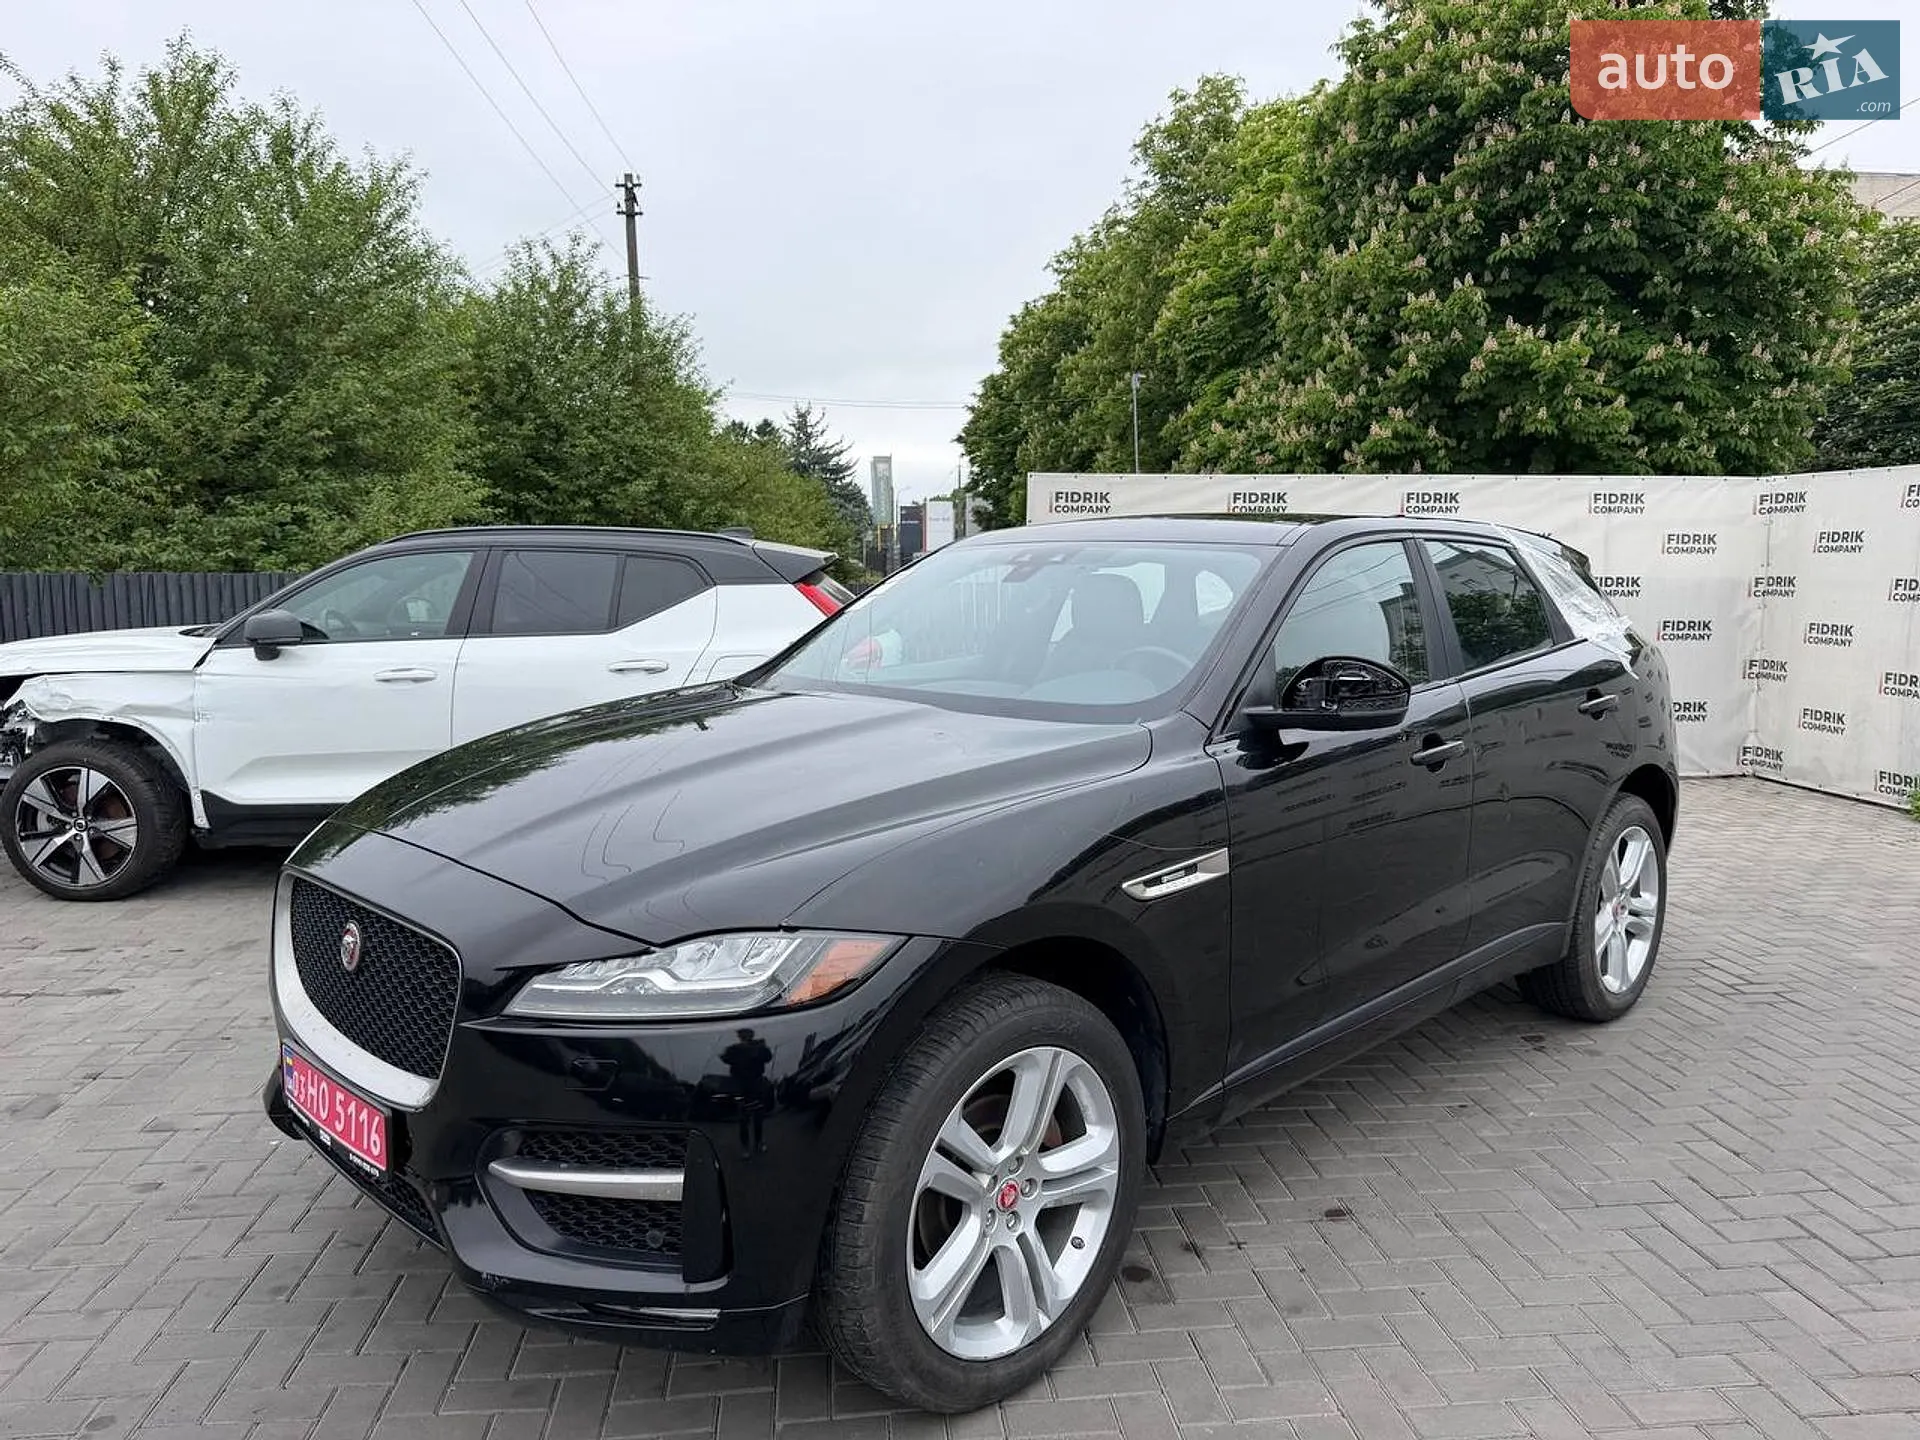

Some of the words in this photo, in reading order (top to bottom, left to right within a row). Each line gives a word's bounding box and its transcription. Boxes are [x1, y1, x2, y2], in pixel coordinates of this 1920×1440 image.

[1054, 491, 1111, 503] FIDRIK
[1232, 492, 1288, 504] FIDRIK
[1405, 492, 1460, 504] FIDRIK
[1593, 493, 1645, 504] FIDRIK
[1759, 491, 1808, 505] FIDRIK
[1054, 505, 1111, 513] COMPANY
[1405, 505, 1460, 513] COMPANY
[1593, 505, 1645, 514] COMPANY
[1666, 533, 1717, 545] FIDRIK
[1817, 530, 1865, 544] FIDRIK
[1665, 546, 1717, 555] COMPANY
[1817, 543, 1864, 553] COMPANY
[1594, 576, 1641, 588] IDRIK
[1754, 576, 1796, 588] FDRIK
[1894, 579, 1920, 591] FID
[1662, 620, 1712, 631] FIDRIK
[1808, 622, 1854, 637] FIDRIK
[1661, 632, 1712, 641] COMPANY
[1807, 635, 1853, 647] COMPANY
[1884, 672, 1919, 688] FIDR
[1883, 687, 1920, 699] COMPA
[1673, 702, 1708, 712] DRIK
[1802, 707, 1848, 725] FIDRIK
[1801, 721, 1847, 736] COMPANY
[1880, 771, 1920, 790] FIDRI
[335, 1092, 380, 1157] 5116
